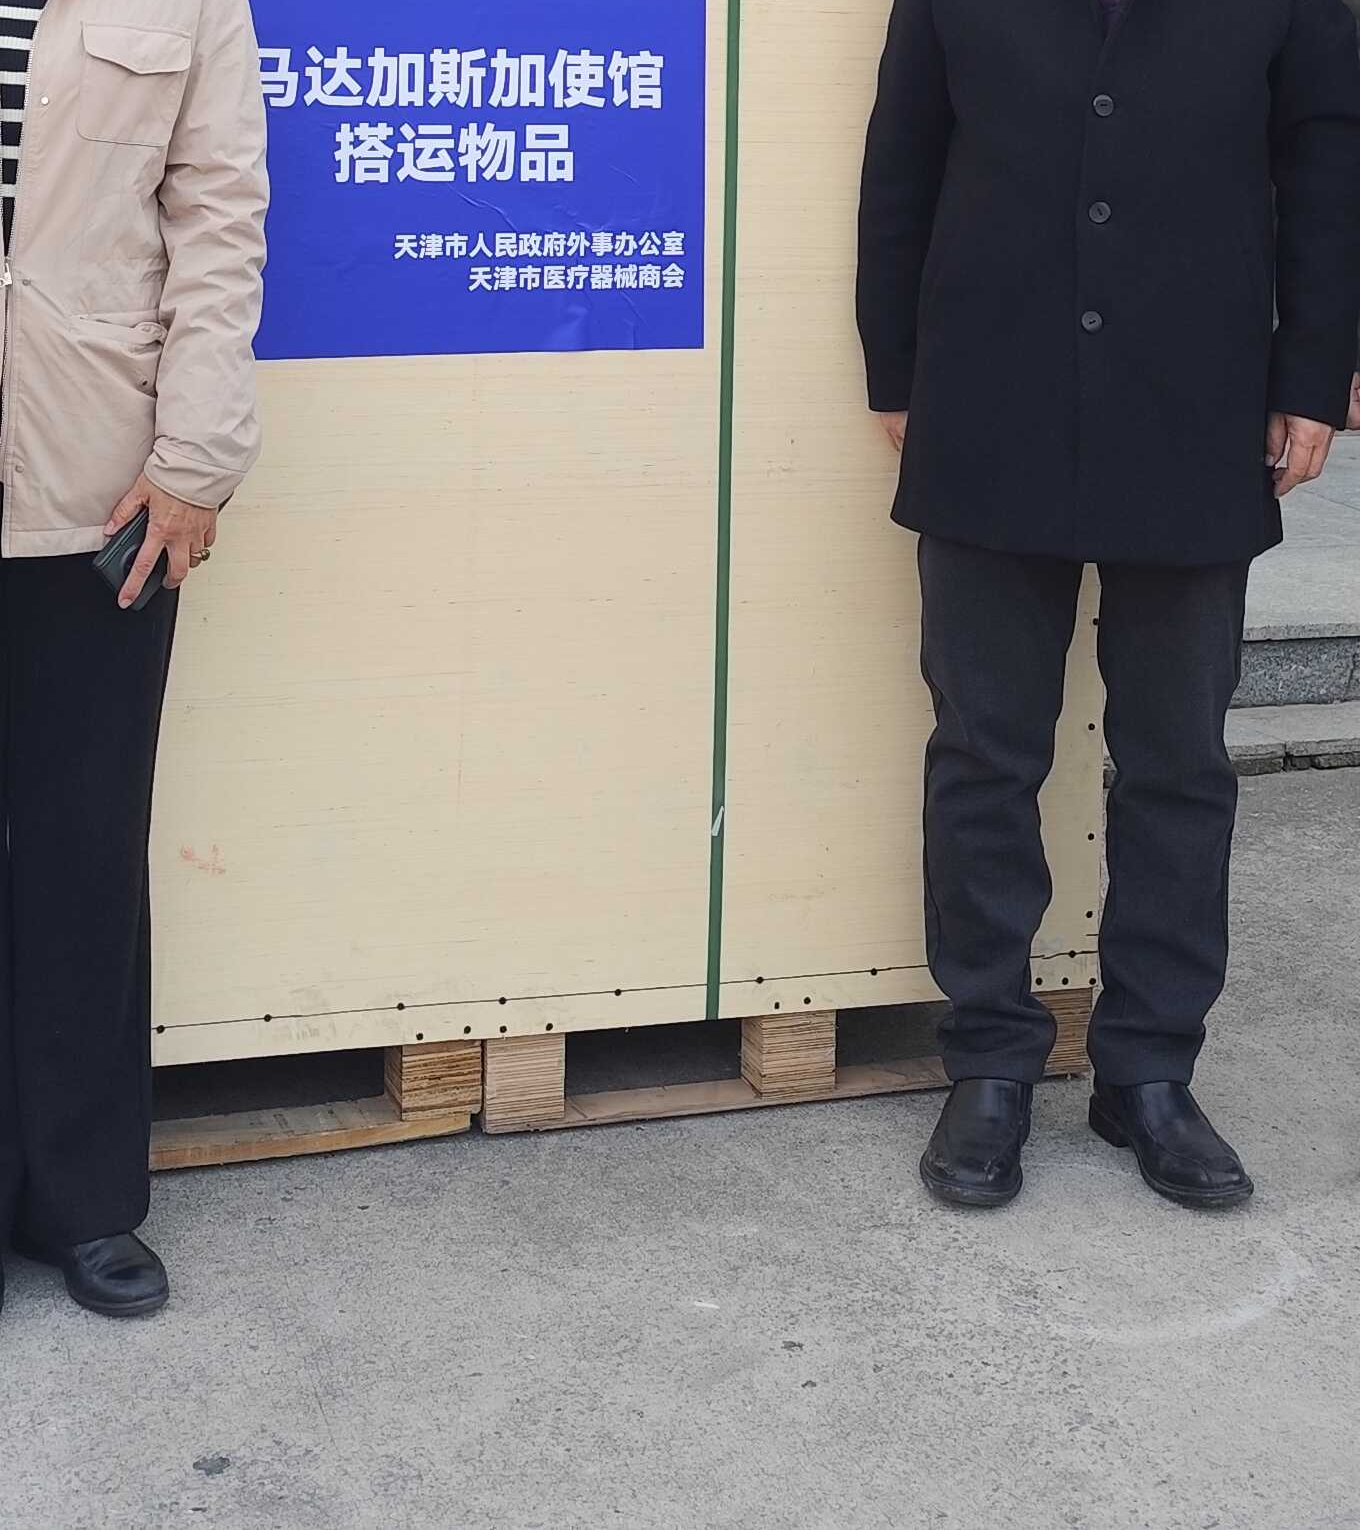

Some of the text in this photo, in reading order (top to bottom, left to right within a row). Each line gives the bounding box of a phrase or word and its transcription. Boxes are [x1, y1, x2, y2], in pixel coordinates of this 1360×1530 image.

[258, 45, 664, 110] 马达加斯加使馆
[334, 123, 575, 183] 搭运物品
[394, 231, 686, 259] 天津市人民政府外事办公室
[468, 263, 685, 291] 天津市医疗器械商会
